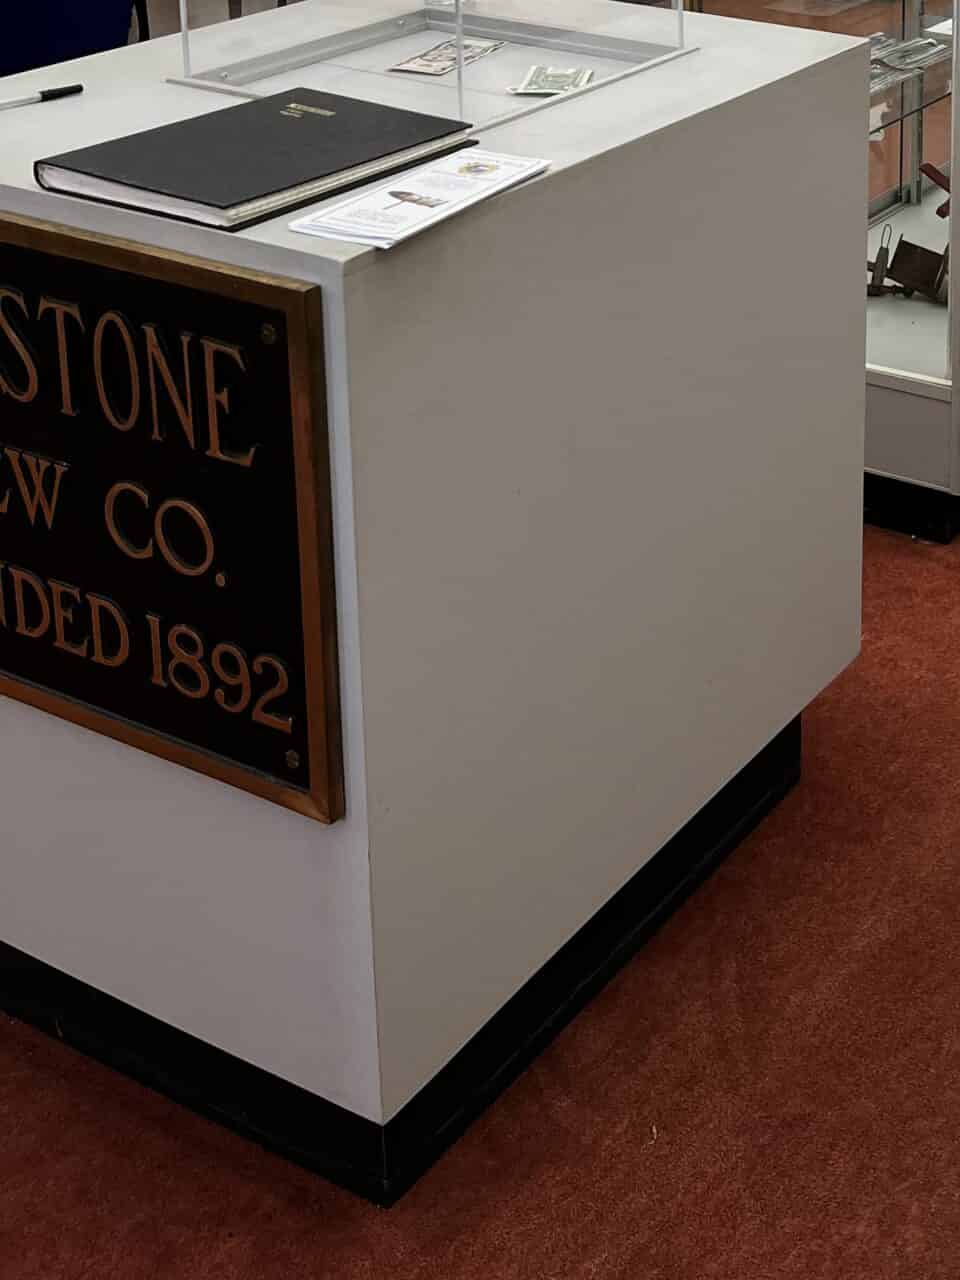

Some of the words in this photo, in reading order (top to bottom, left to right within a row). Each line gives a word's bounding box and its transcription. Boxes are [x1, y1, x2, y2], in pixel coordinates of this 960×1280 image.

[103, 481, 227, 588] CO.
[0, 562, 130, 667] DED
[145, 613, 294, 735] 1892
